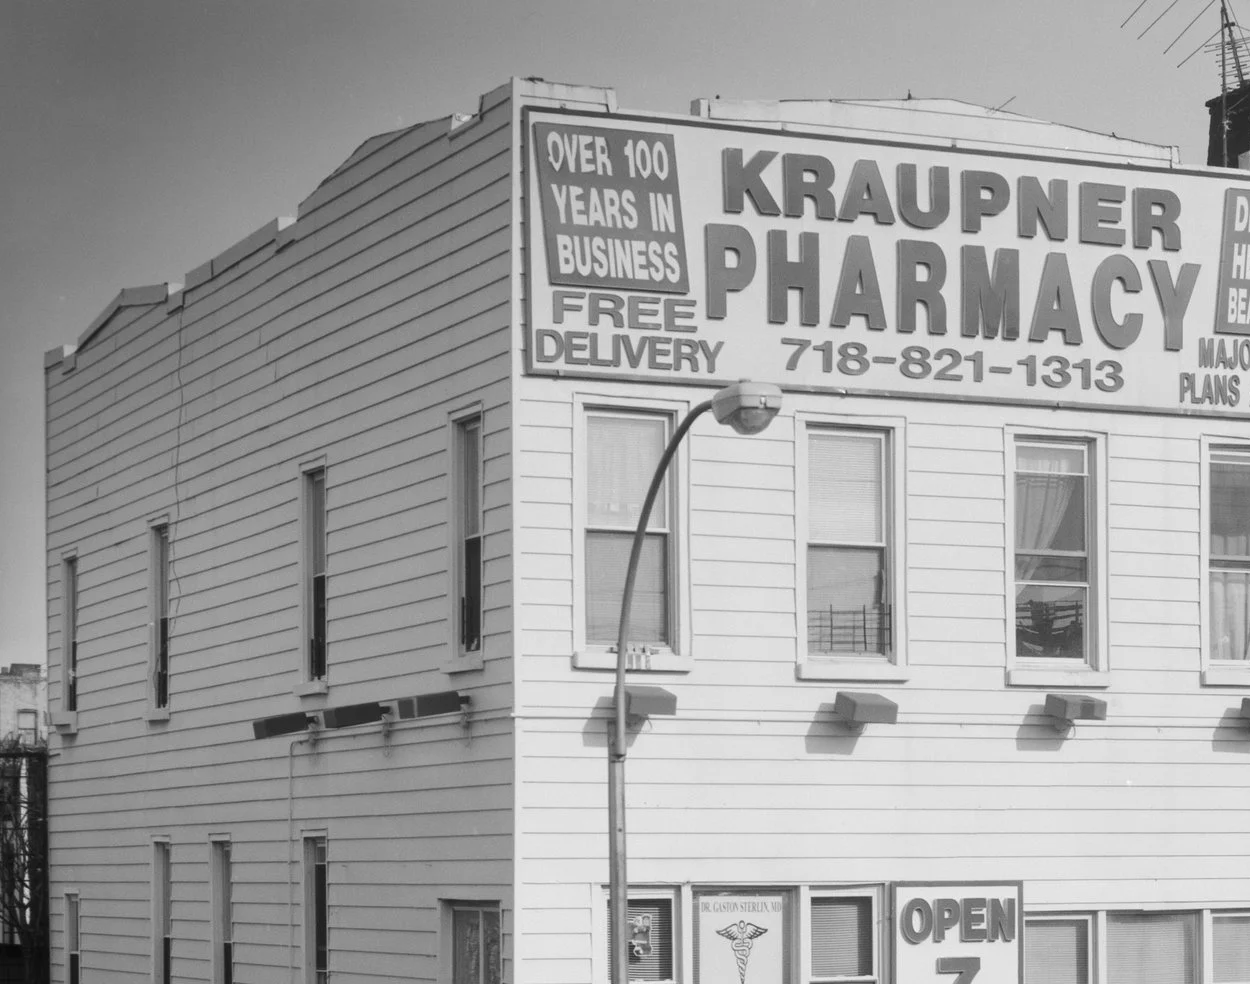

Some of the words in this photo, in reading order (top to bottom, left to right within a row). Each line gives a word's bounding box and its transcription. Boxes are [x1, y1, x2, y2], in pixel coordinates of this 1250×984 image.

[546, 130, 613, 177] OVER
[623, 138, 670, 181] 100
[550, 183, 640, 231] YEARS
[649, 191, 676, 233] IN
[721, 146, 1182, 251] KRAUPNER
[556, 233, 682, 284] BUSINESS
[551, 289, 698, 333] FREE
[704, 222, 1202, 352] PHARMACY
[535, 328, 725, 374] DELIVERY
[780, 337, 1125, 393] 718-821-1313
[1178, 371, 1241, 408] PLANS
[900, 897, 1016, 945] OPEN
